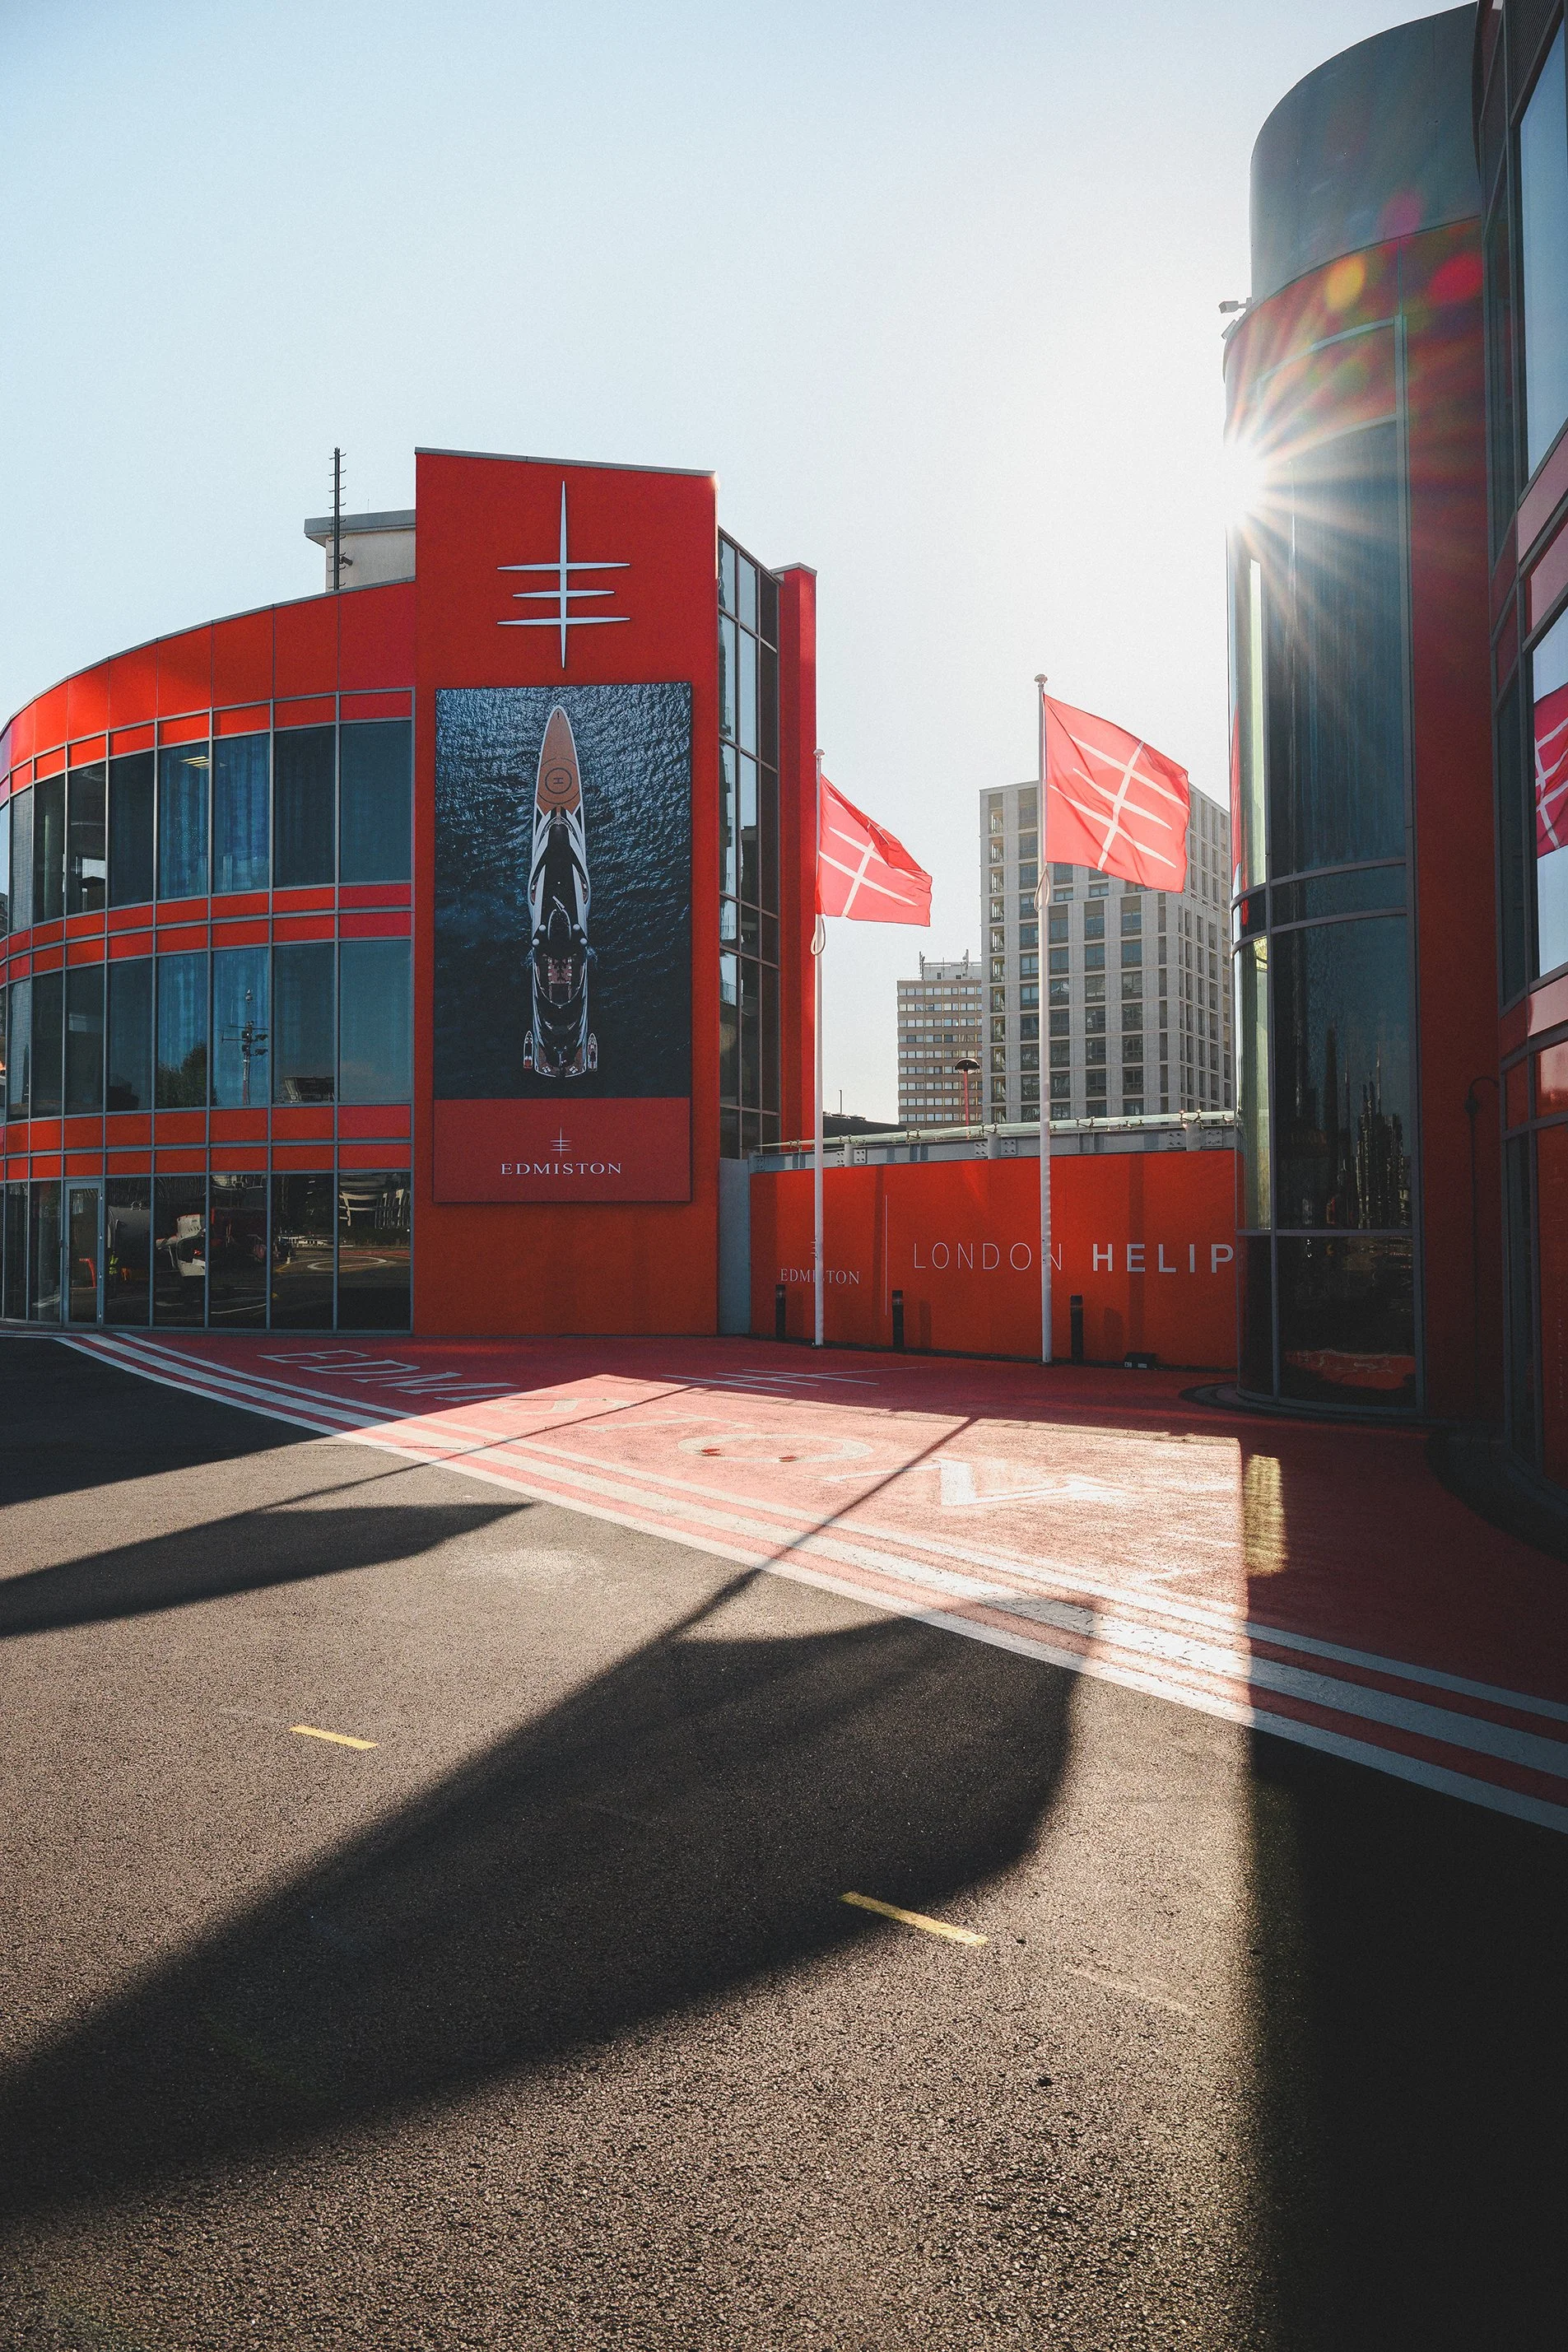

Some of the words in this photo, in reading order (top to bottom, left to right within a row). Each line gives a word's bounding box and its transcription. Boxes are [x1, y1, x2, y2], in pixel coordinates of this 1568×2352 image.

[500, 1162, 622, 1175] EDMISTON
[1092, 1243, 1234, 1274] HELIP
[779, 1268, 861, 1285] EDMITON
